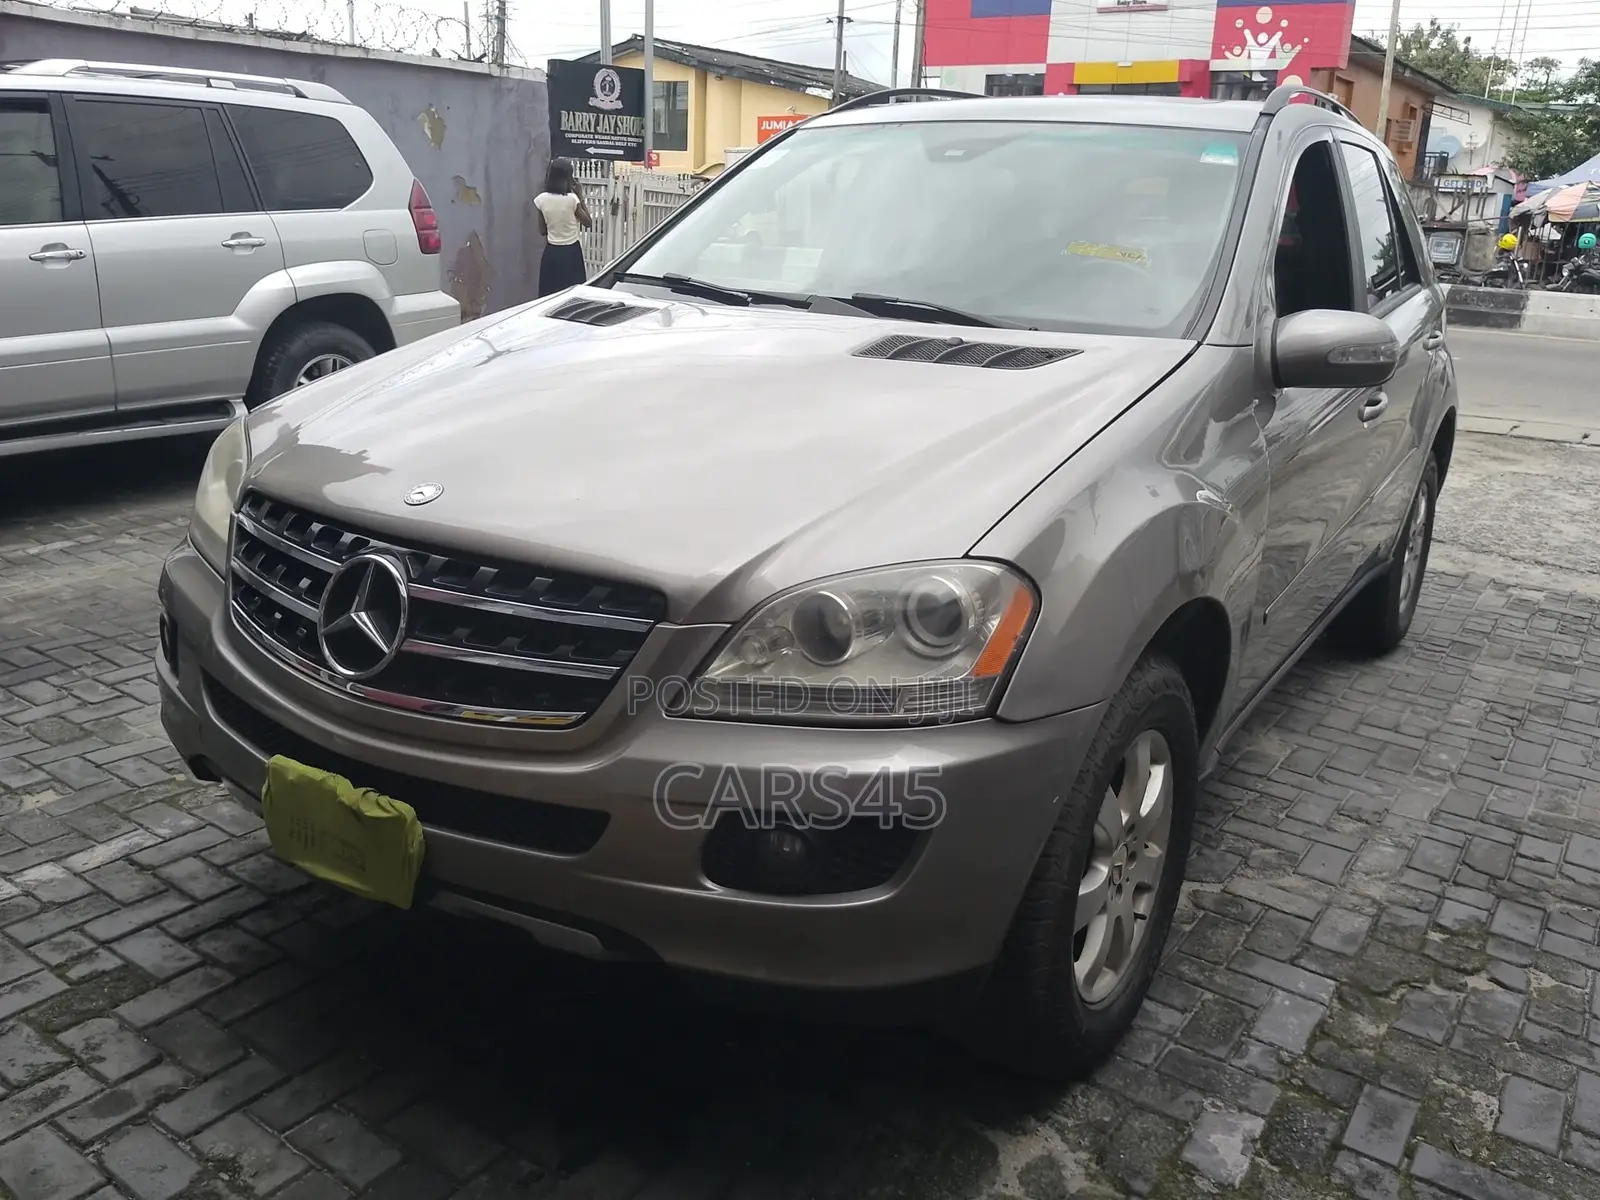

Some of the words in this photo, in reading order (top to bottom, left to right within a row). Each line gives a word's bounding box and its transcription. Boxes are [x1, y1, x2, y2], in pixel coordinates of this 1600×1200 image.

[560, 110, 597, 133] BARRY
[597, 113, 616, 134] JAY
[761, 120, 794, 130] JUMIA
